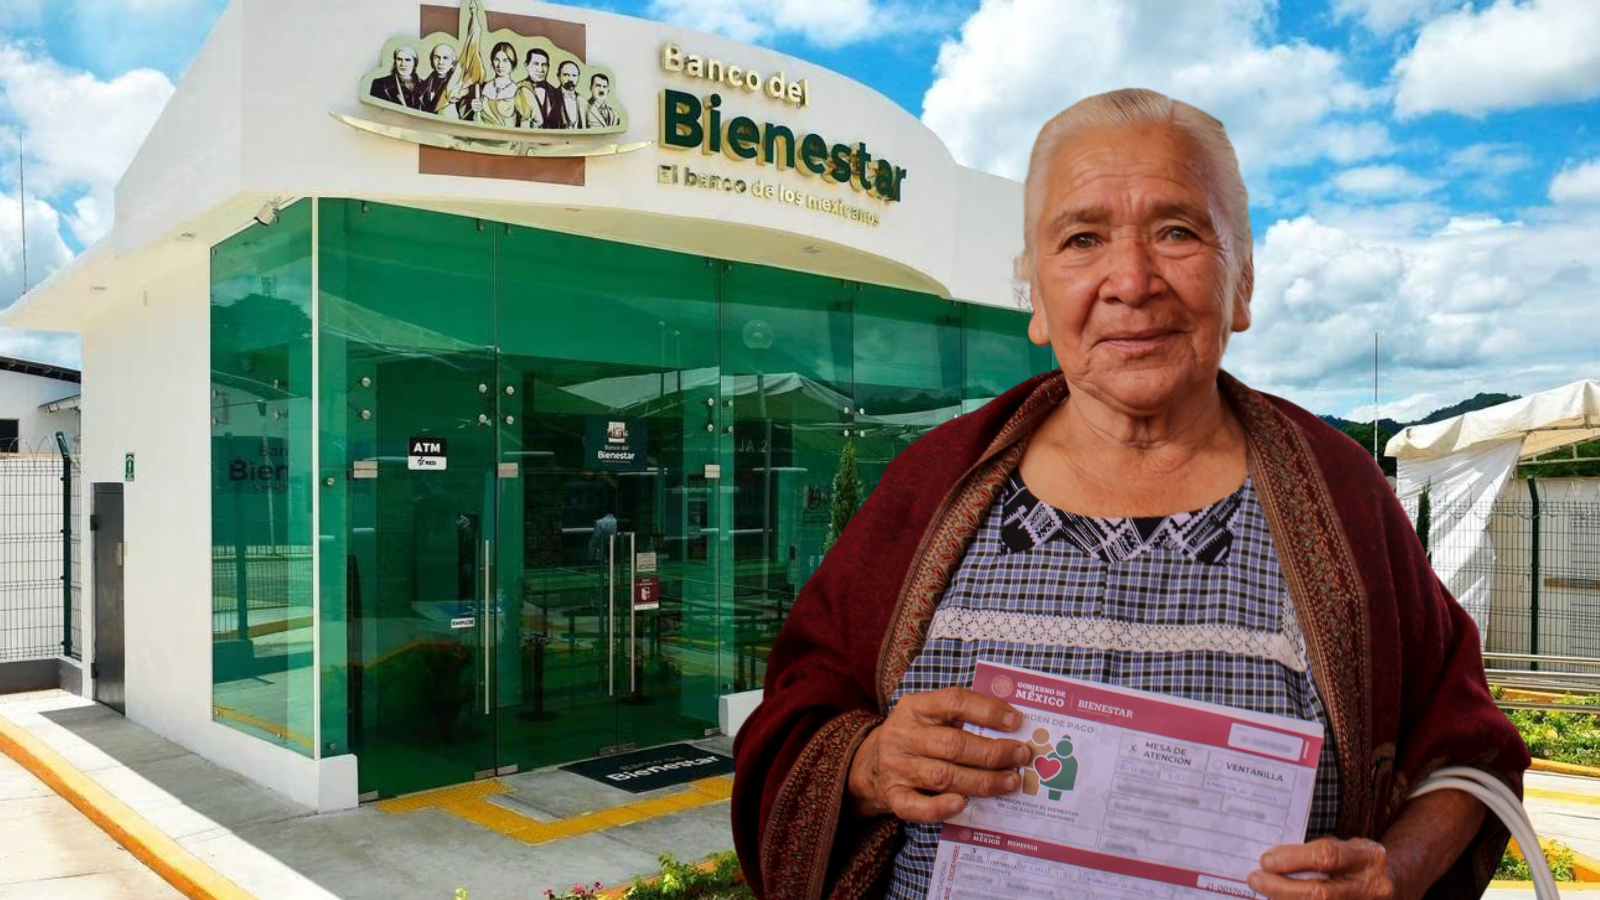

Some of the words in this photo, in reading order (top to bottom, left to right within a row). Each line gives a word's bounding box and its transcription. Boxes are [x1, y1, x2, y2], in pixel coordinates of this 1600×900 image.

[662, 43, 761, 93] Banco
[764, 70, 810, 108] del
[659, 88, 907, 203] Bienestar
[684, 166, 748, 194] banco
[751, 179, 774, 200] de
[778, 183, 804, 206] los
[805, 193, 881, 228] mexicanos
[413, 442, 441, 453] ATM
[597, 450, 635, 460] Bienestar
[1015, 688, 1065, 708] MÉXICO
[1017, 681, 1055, 695] GOBIERNO
[1056, 690, 1067, 698] DE
[1077, 699, 1134, 719] BIENESTAR
[1052, 718, 1065, 728] DE
[1067, 721, 1094, 733] PAGO
[1145, 741, 1172, 753] MESA
[1173, 747, 1187, 756] DE
[606, 755, 721, 782] Bienestar
[1226, 762, 1284, 782] VENTANILLA
[1019, 806, 1046, 817] ADULTOS
[1046, 813, 1075, 823] MAYORES
[1047, 806, 1079, 817] BIENESTAR
[972, 834, 1001, 845] MÉXICO
[1007, 839, 1038, 851] BIENESTAR
[947, 844, 960, 881] DICIEMBRE
